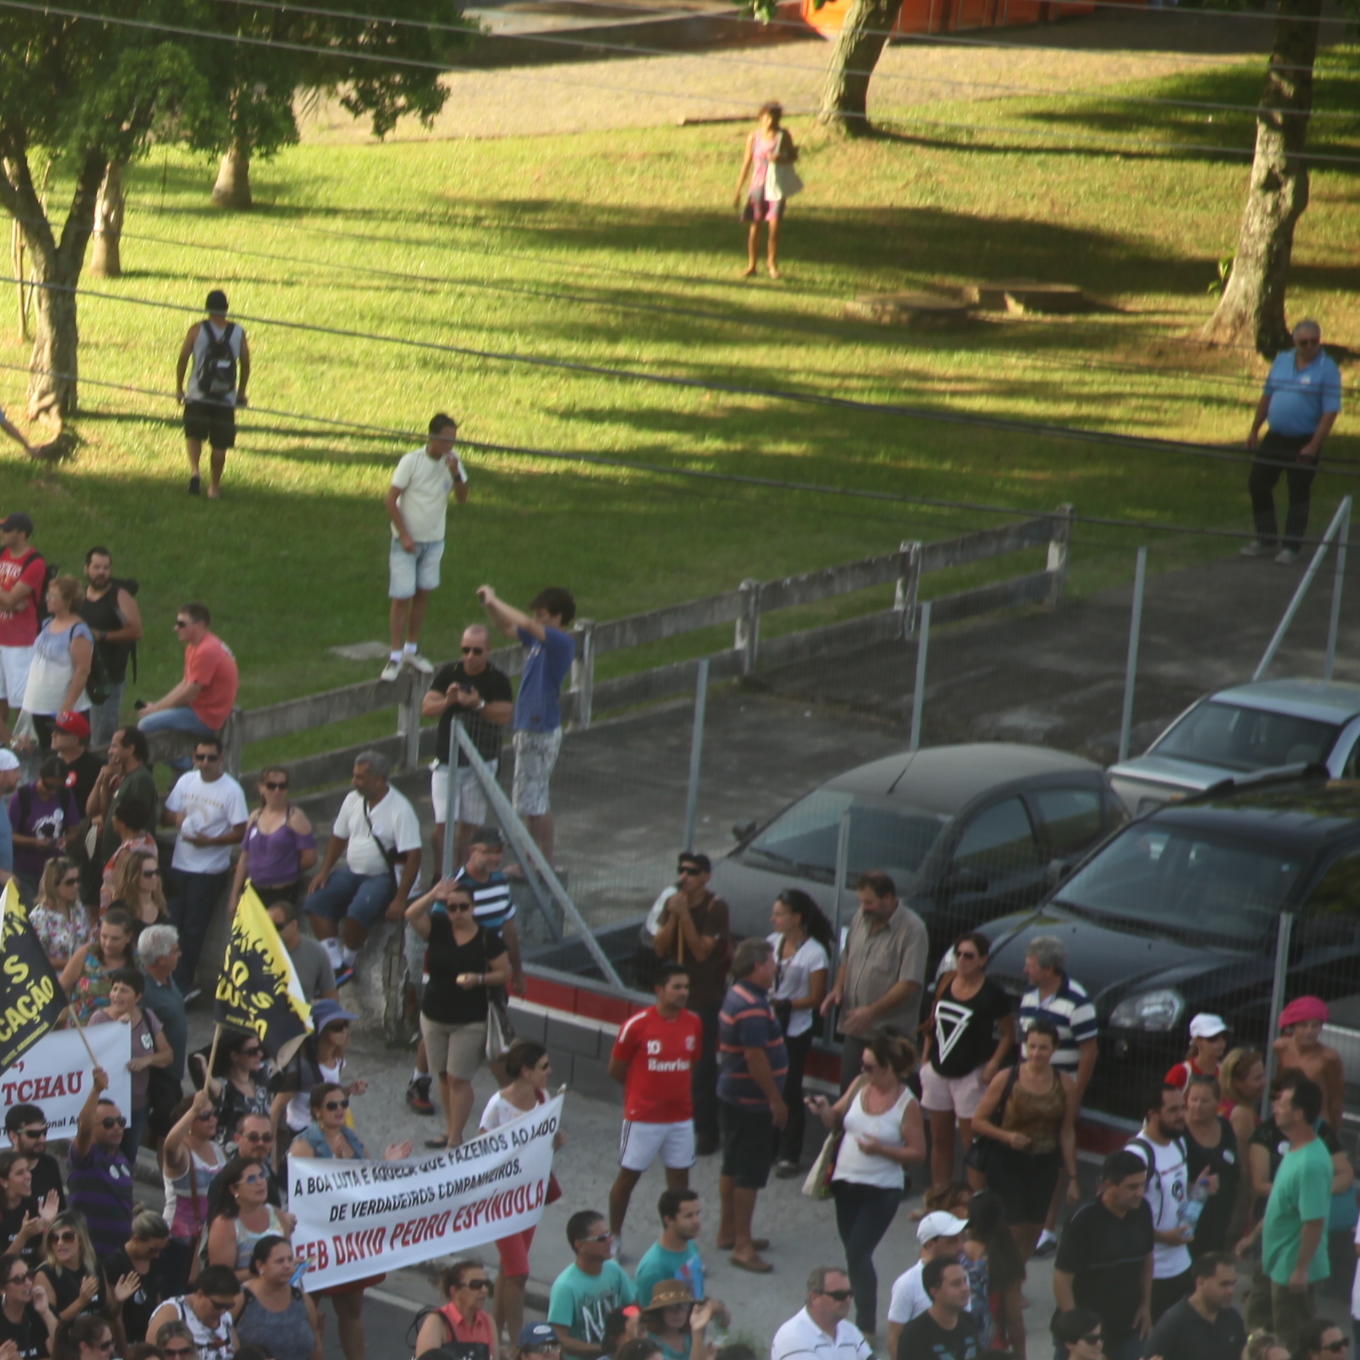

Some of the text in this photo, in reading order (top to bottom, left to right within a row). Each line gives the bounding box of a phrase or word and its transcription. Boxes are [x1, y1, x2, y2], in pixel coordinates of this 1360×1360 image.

[0, 1070, 84, 1107] TCHAU
[294, 1178, 303, 1197] A
[307, 1173, 333, 1195] BOA
[333, 1168, 361, 1191] LUTA
[448, 1134, 509, 1166] FAZEMOS
[512, 1127, 529, 1149] AO
[329, 1158, 523, 1223] DE VERDADEIROS COMPANHEIROS.
[332, 1227, 386, 1267] DAVID
[389, 1210, 452, 1251] PEDRO
[452, 1178, 545, 1233] ESPÍNDOLA
